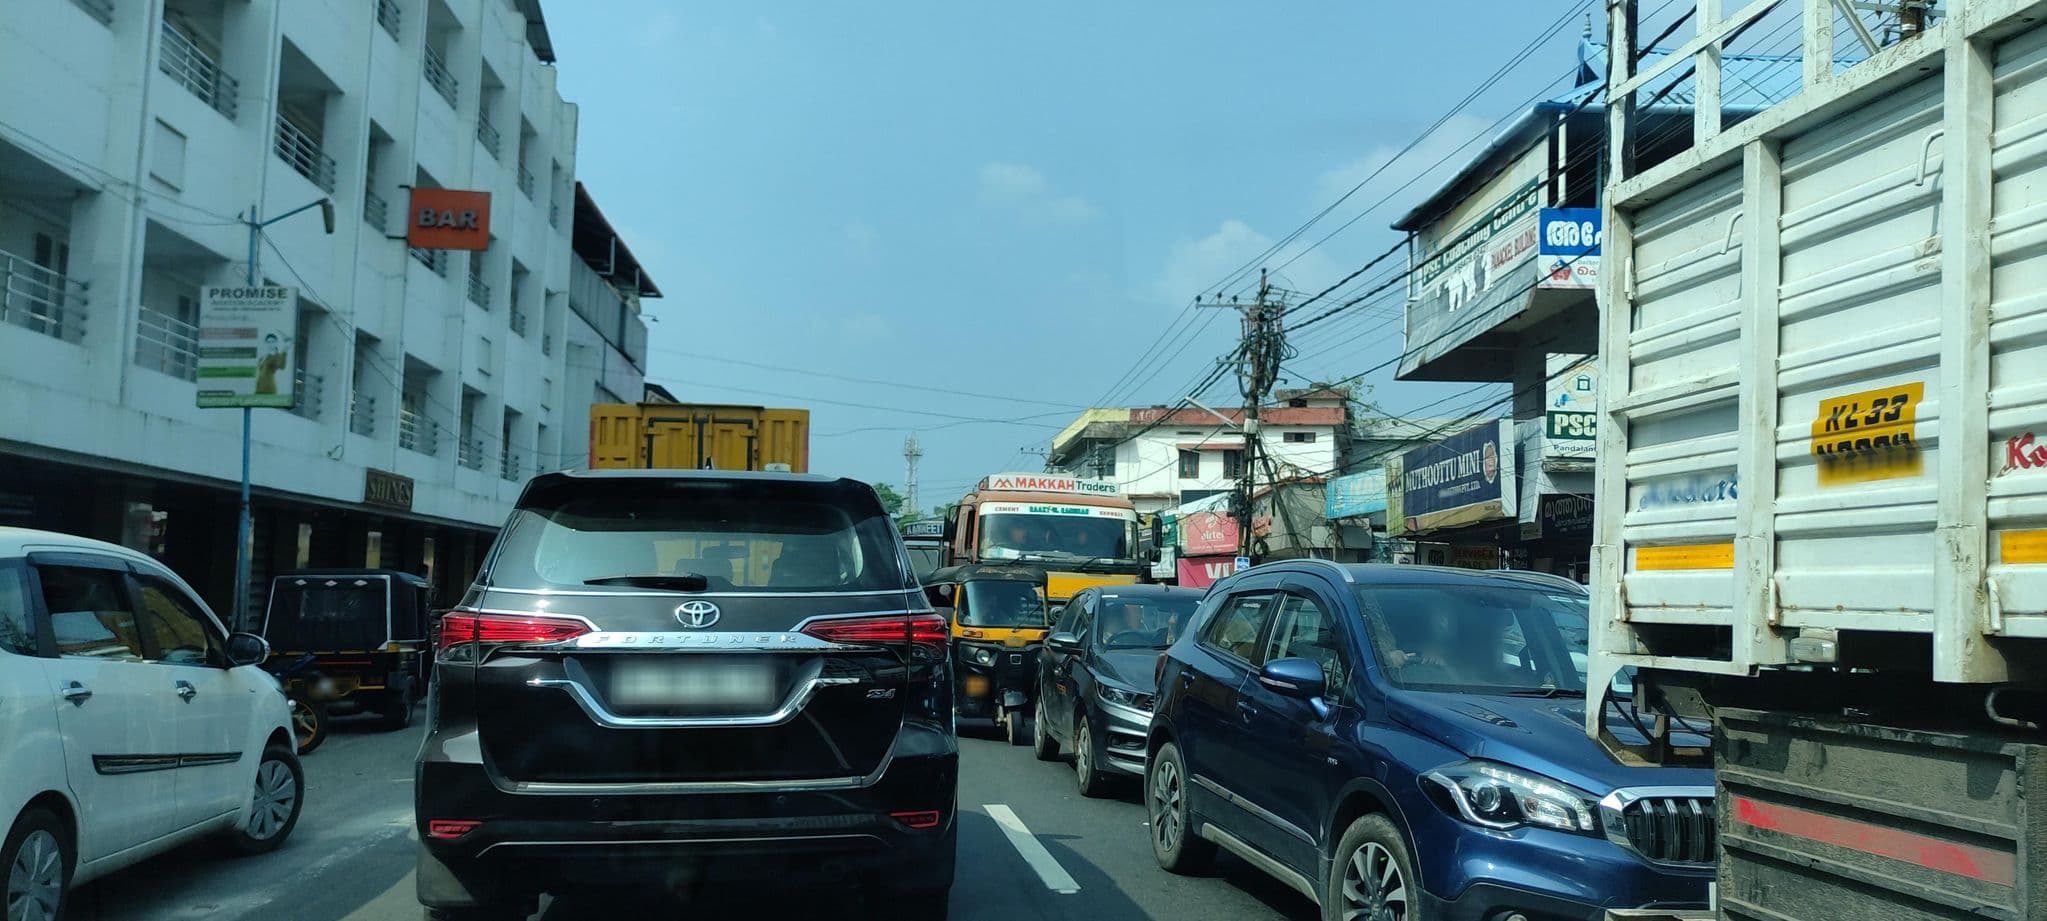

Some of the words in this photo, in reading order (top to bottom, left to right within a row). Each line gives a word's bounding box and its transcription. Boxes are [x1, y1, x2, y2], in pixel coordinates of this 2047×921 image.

[417, 208, 479, 231] BAR
[209, 287, 289, 299] PROMISE
[1554, 413, 1596, 436] PSC
[1405, 457, 1457, 493] MUTHOOTTU
[1458, 450, 1481, 479] MINI
[368, 478, 412, 505] SHINES
[1015, 477, 1075, 491] MAKKAH
[1076, 480, 1116, 493] Traders
[596, 635, 797, 644] FORTUNER
